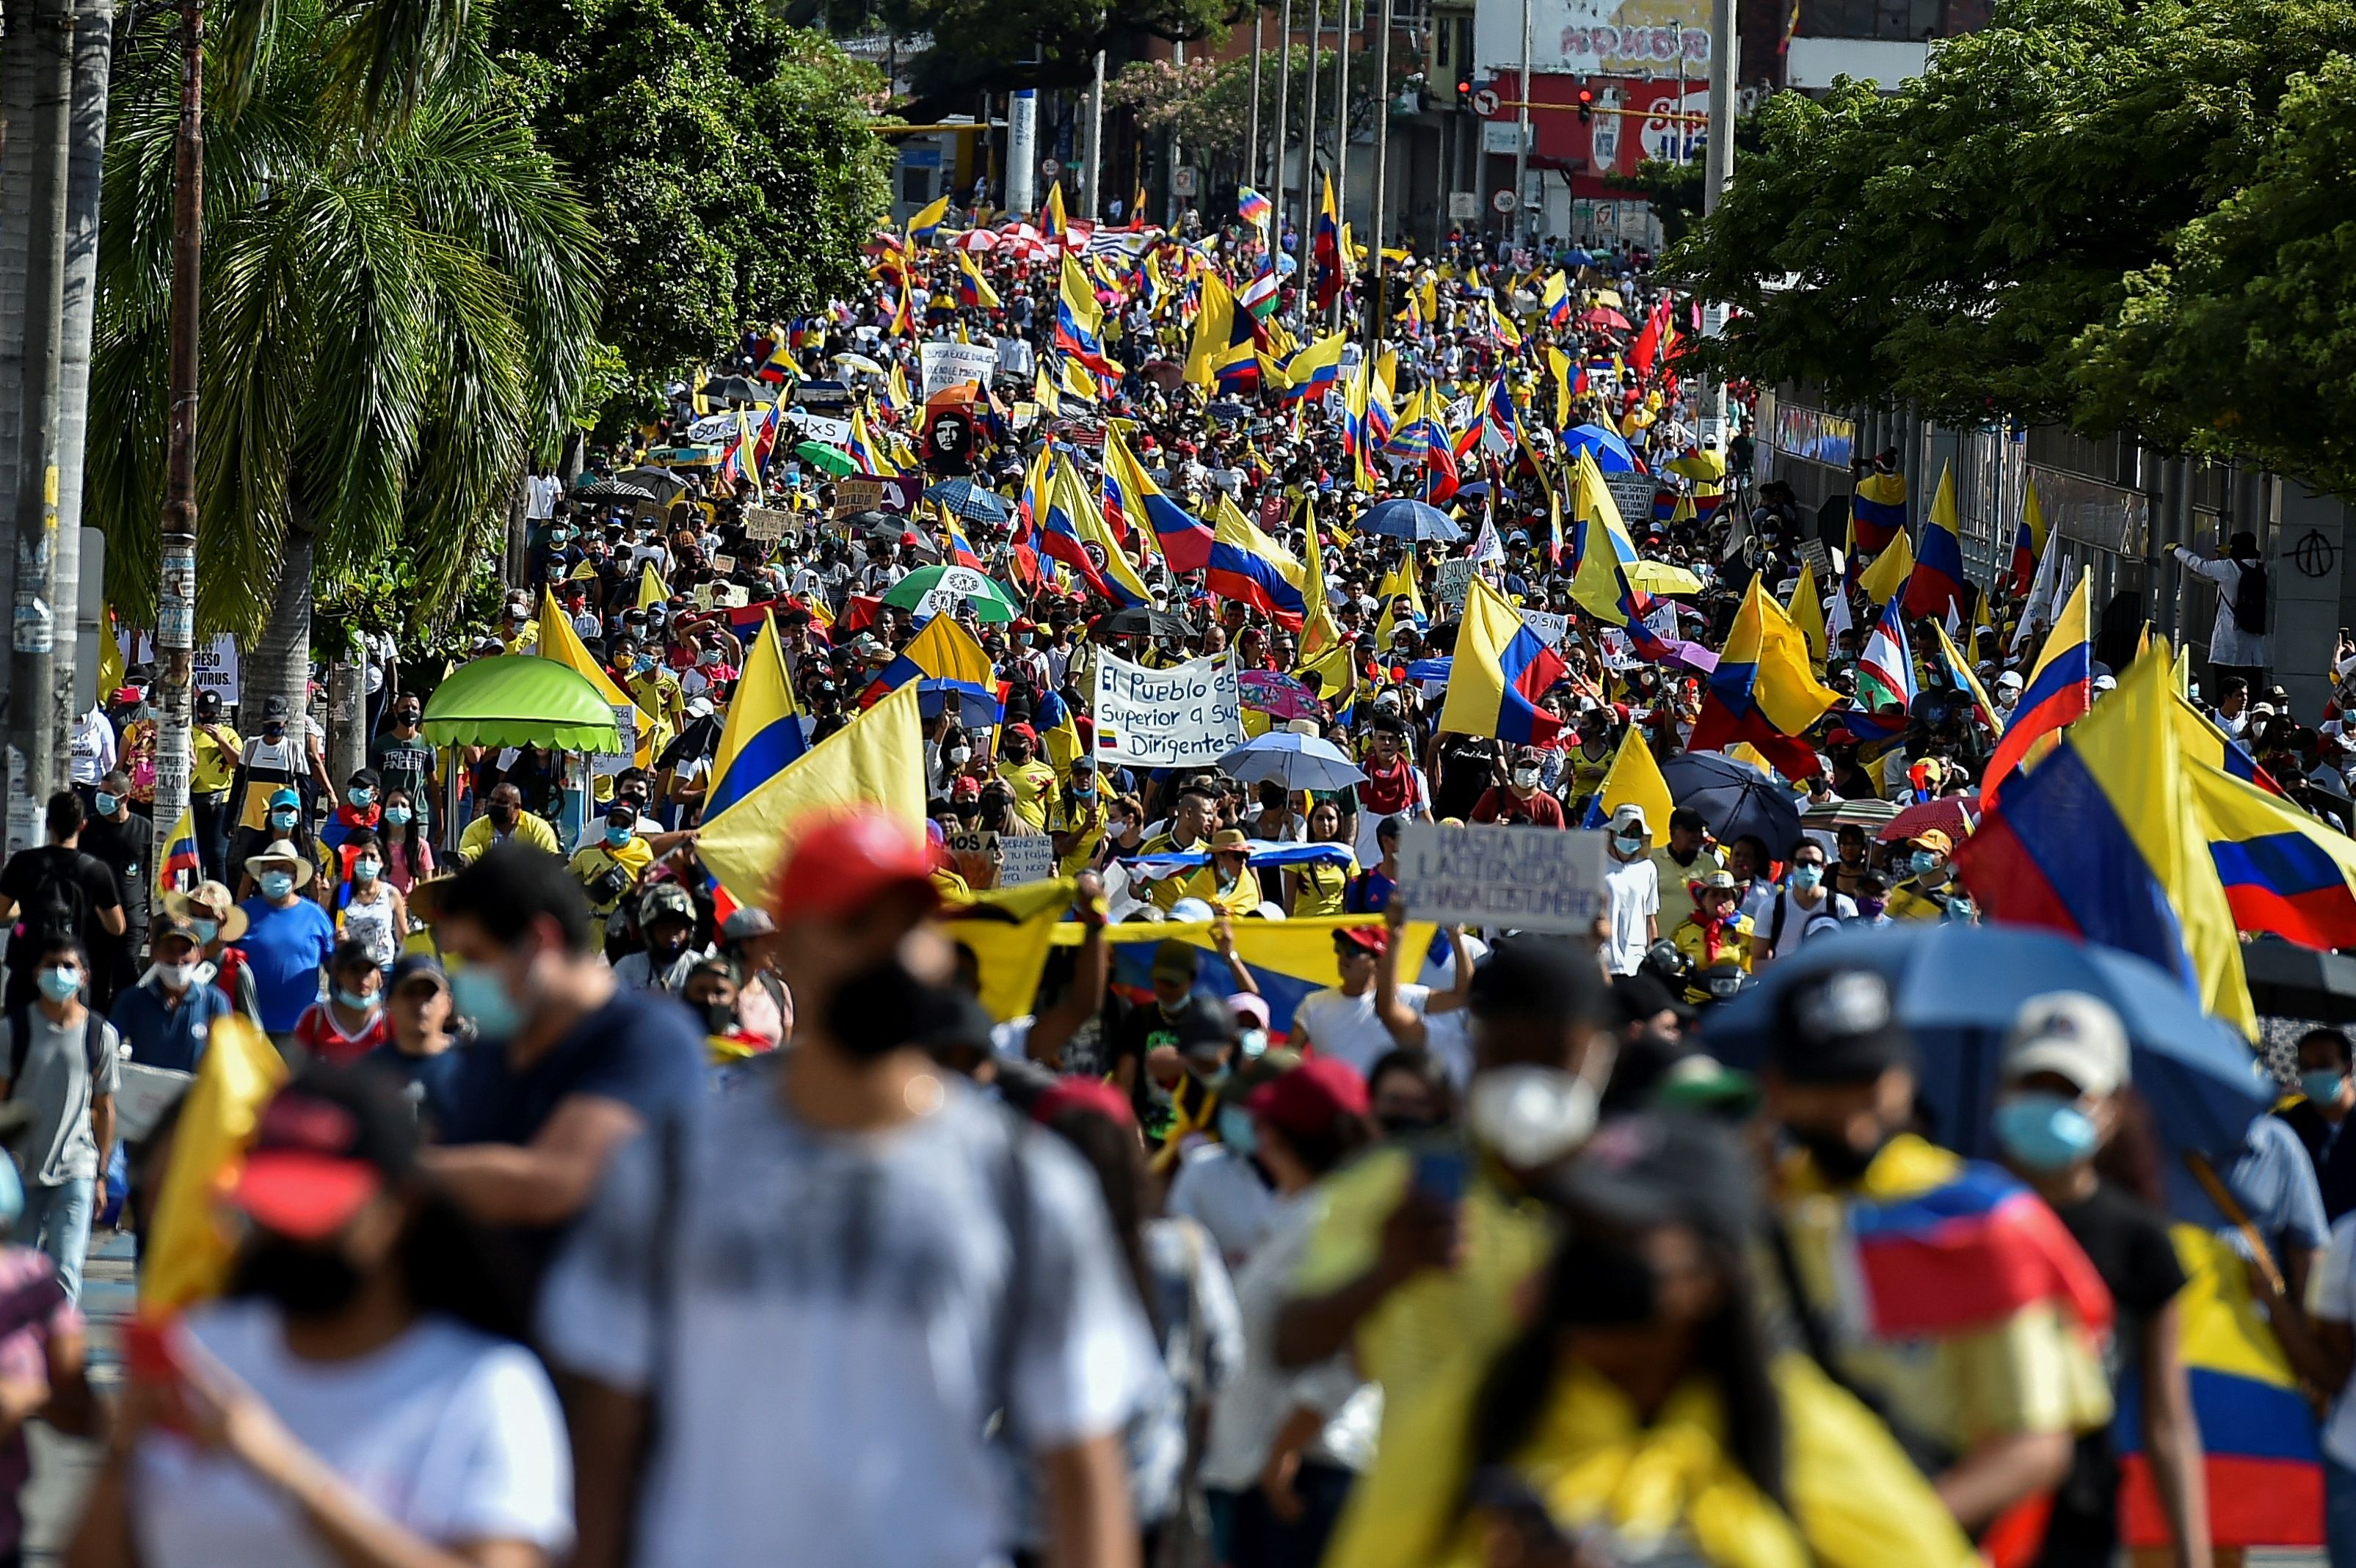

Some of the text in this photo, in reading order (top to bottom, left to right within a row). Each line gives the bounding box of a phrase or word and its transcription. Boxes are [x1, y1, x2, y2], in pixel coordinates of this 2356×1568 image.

[1542, 617, 1563, 630] SIN
[197, 672, 232, 685] VIRUS.
[1102, 666, 1236, 701] El Pueblo es
[1102, 704, 1180, 732] Superior
[1127, 732, 1237, 764] Dirigentes
